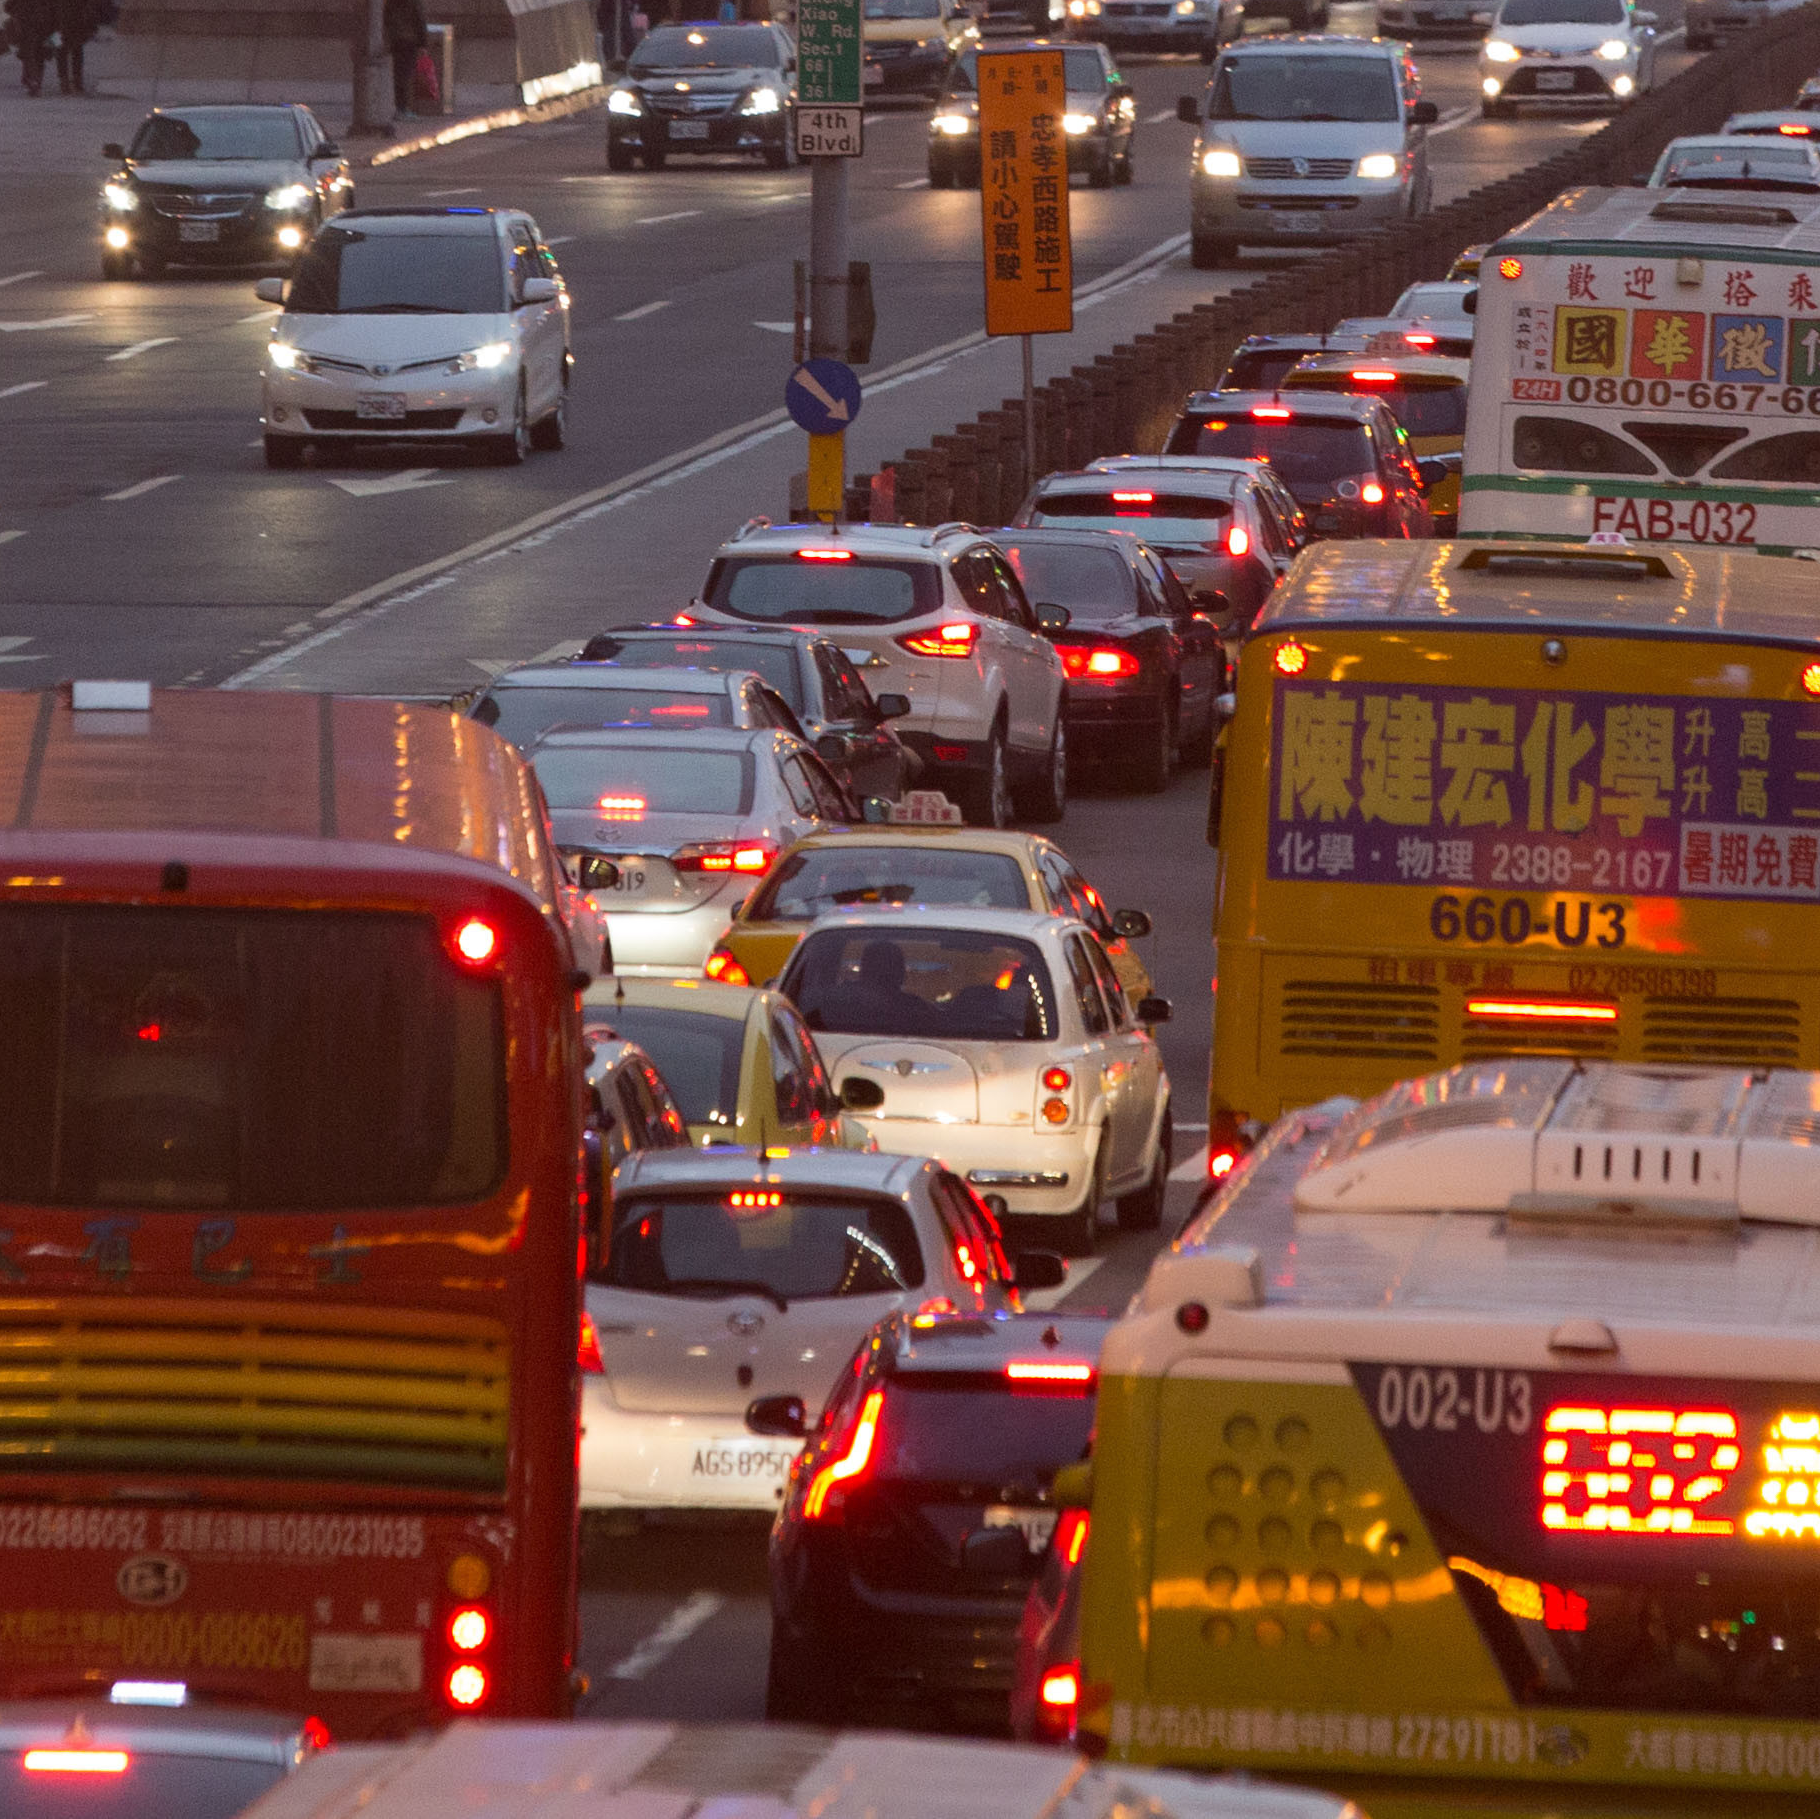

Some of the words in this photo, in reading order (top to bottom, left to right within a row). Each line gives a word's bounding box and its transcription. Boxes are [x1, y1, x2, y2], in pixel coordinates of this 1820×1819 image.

[801, 7, 839, 22] Xiao
[831, 24, 857, 39] Rd.
[811, 110, 848, 130] 4th
[989, 130, 1023, 281] 請小心駕駛
[1031, 112, 1062, 294] 忠孝西路施工
[1566, 262, 1819, 313] 歡迎搭乘
[1516, 380, 1557, 399] 24H
[1591, 496, 1757, 544] FAB-032
[1278, 687, 1676, 838] 陳建宏化學
[1490, 844, 1672, 889] 2388-2167
[1683, 829, 1820, 892] 暑期免費
[1430, 894, 1627, 950] 660-U3
[1381, 1366, 1530, 1434] 002-U3
